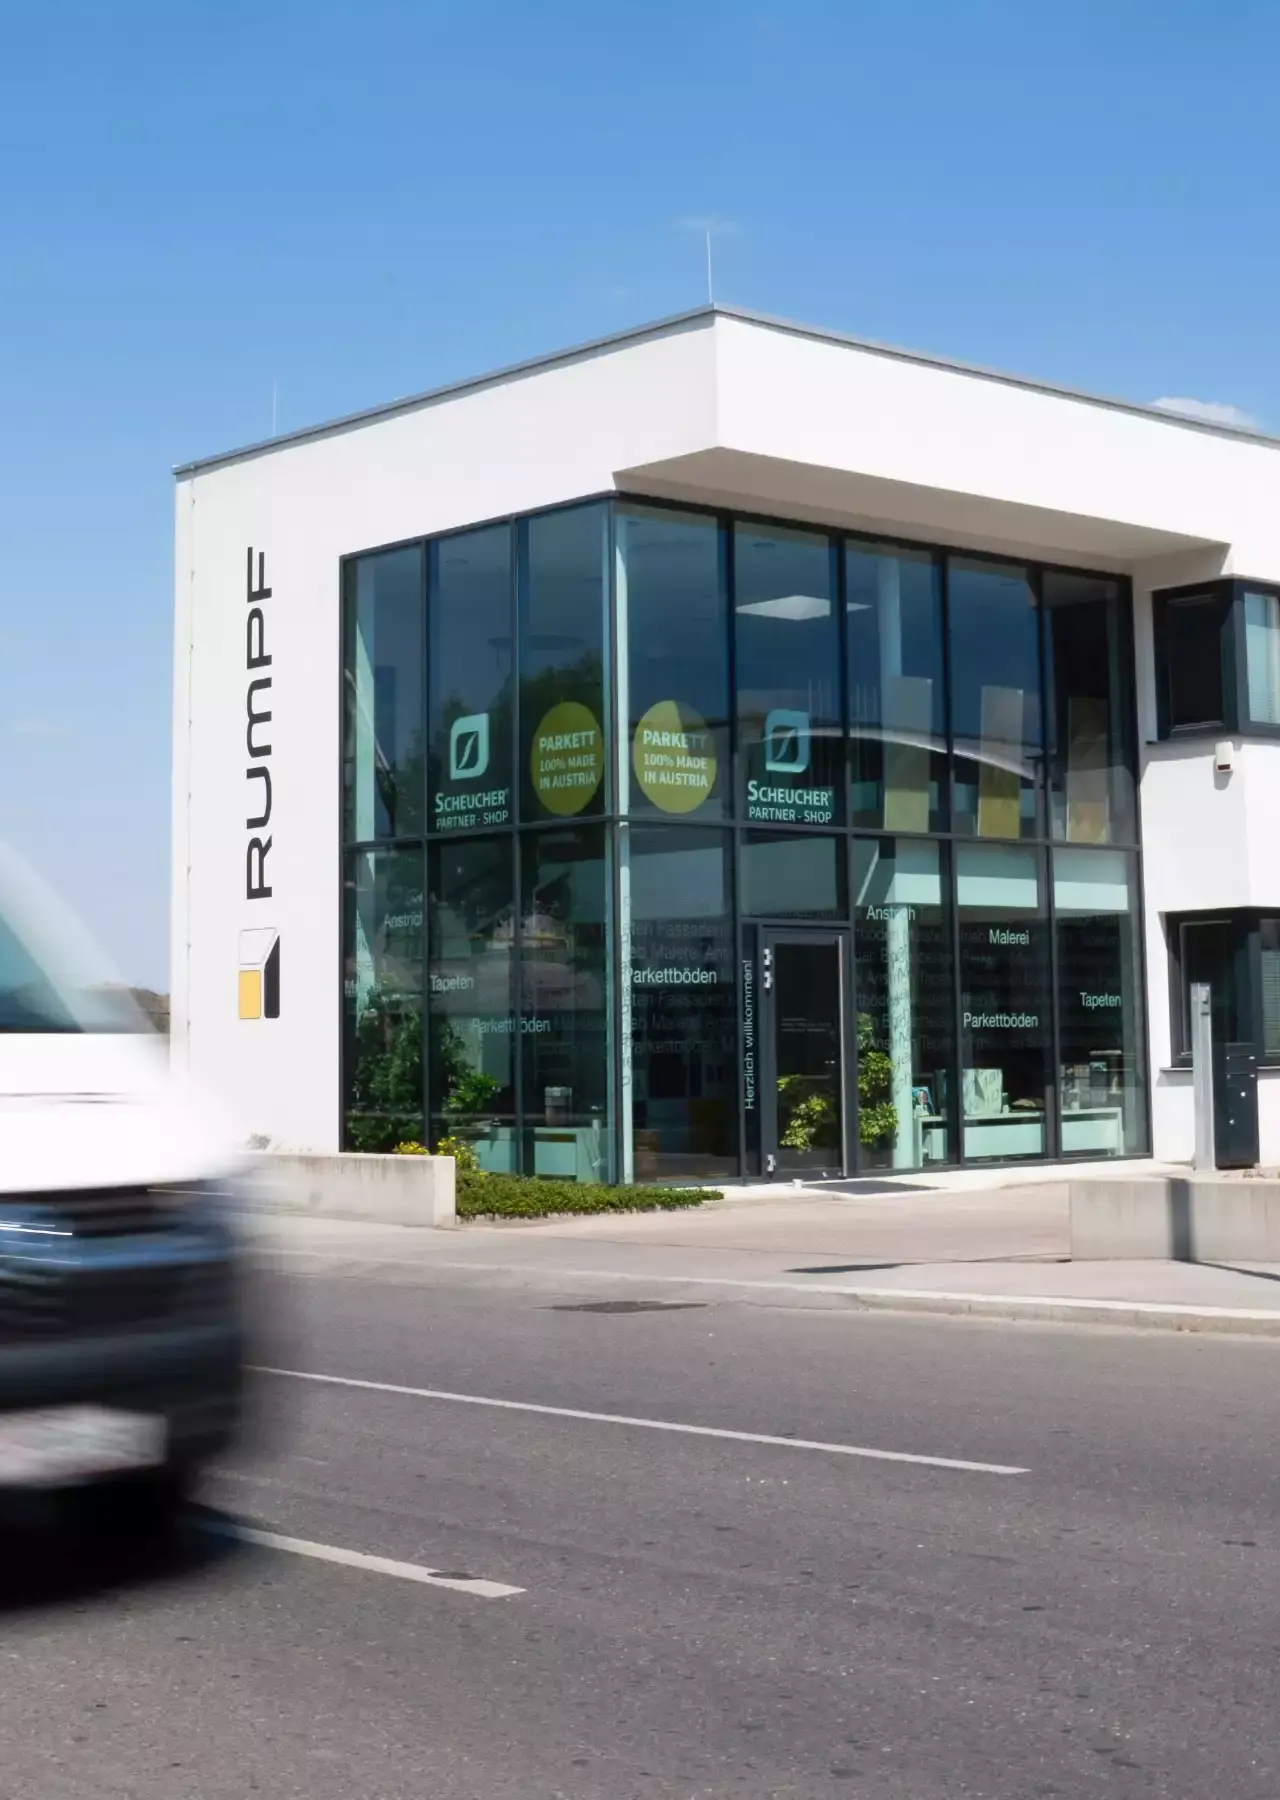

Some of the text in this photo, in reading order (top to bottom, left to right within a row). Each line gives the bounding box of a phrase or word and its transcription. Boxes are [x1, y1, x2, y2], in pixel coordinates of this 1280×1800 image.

[246, 546, 273, 900] RUMPF
[539, 730, 596, 752] PARKETT
[642, 730, 709, 749] PARKETT
[540, 753, 596, 772] 100% MADE
[644, 753, 708, 769] 100% MADE
[540, 771, 596, 789] IN AUSTRIA
[644, 771, 709, 787] IN AUSTRIA
[436, 814, 476, 830] PARTNER
[483, 810, 509, 825] SHOP
[749, 806, 796, 822] PARTNER
[804, 810, 832, 823] SHOP
[866, 905, 916, 921] Ansth
[988, 928, 1030, 945] Malerei
[430, 974, 475, 994] Tapeten
[1079, 991, 1122, 1010] Tapeten
[963, 1012, 1039, 1028] Parkettböden
[742, 960, 755, 1109] Herzlich willkommen!
